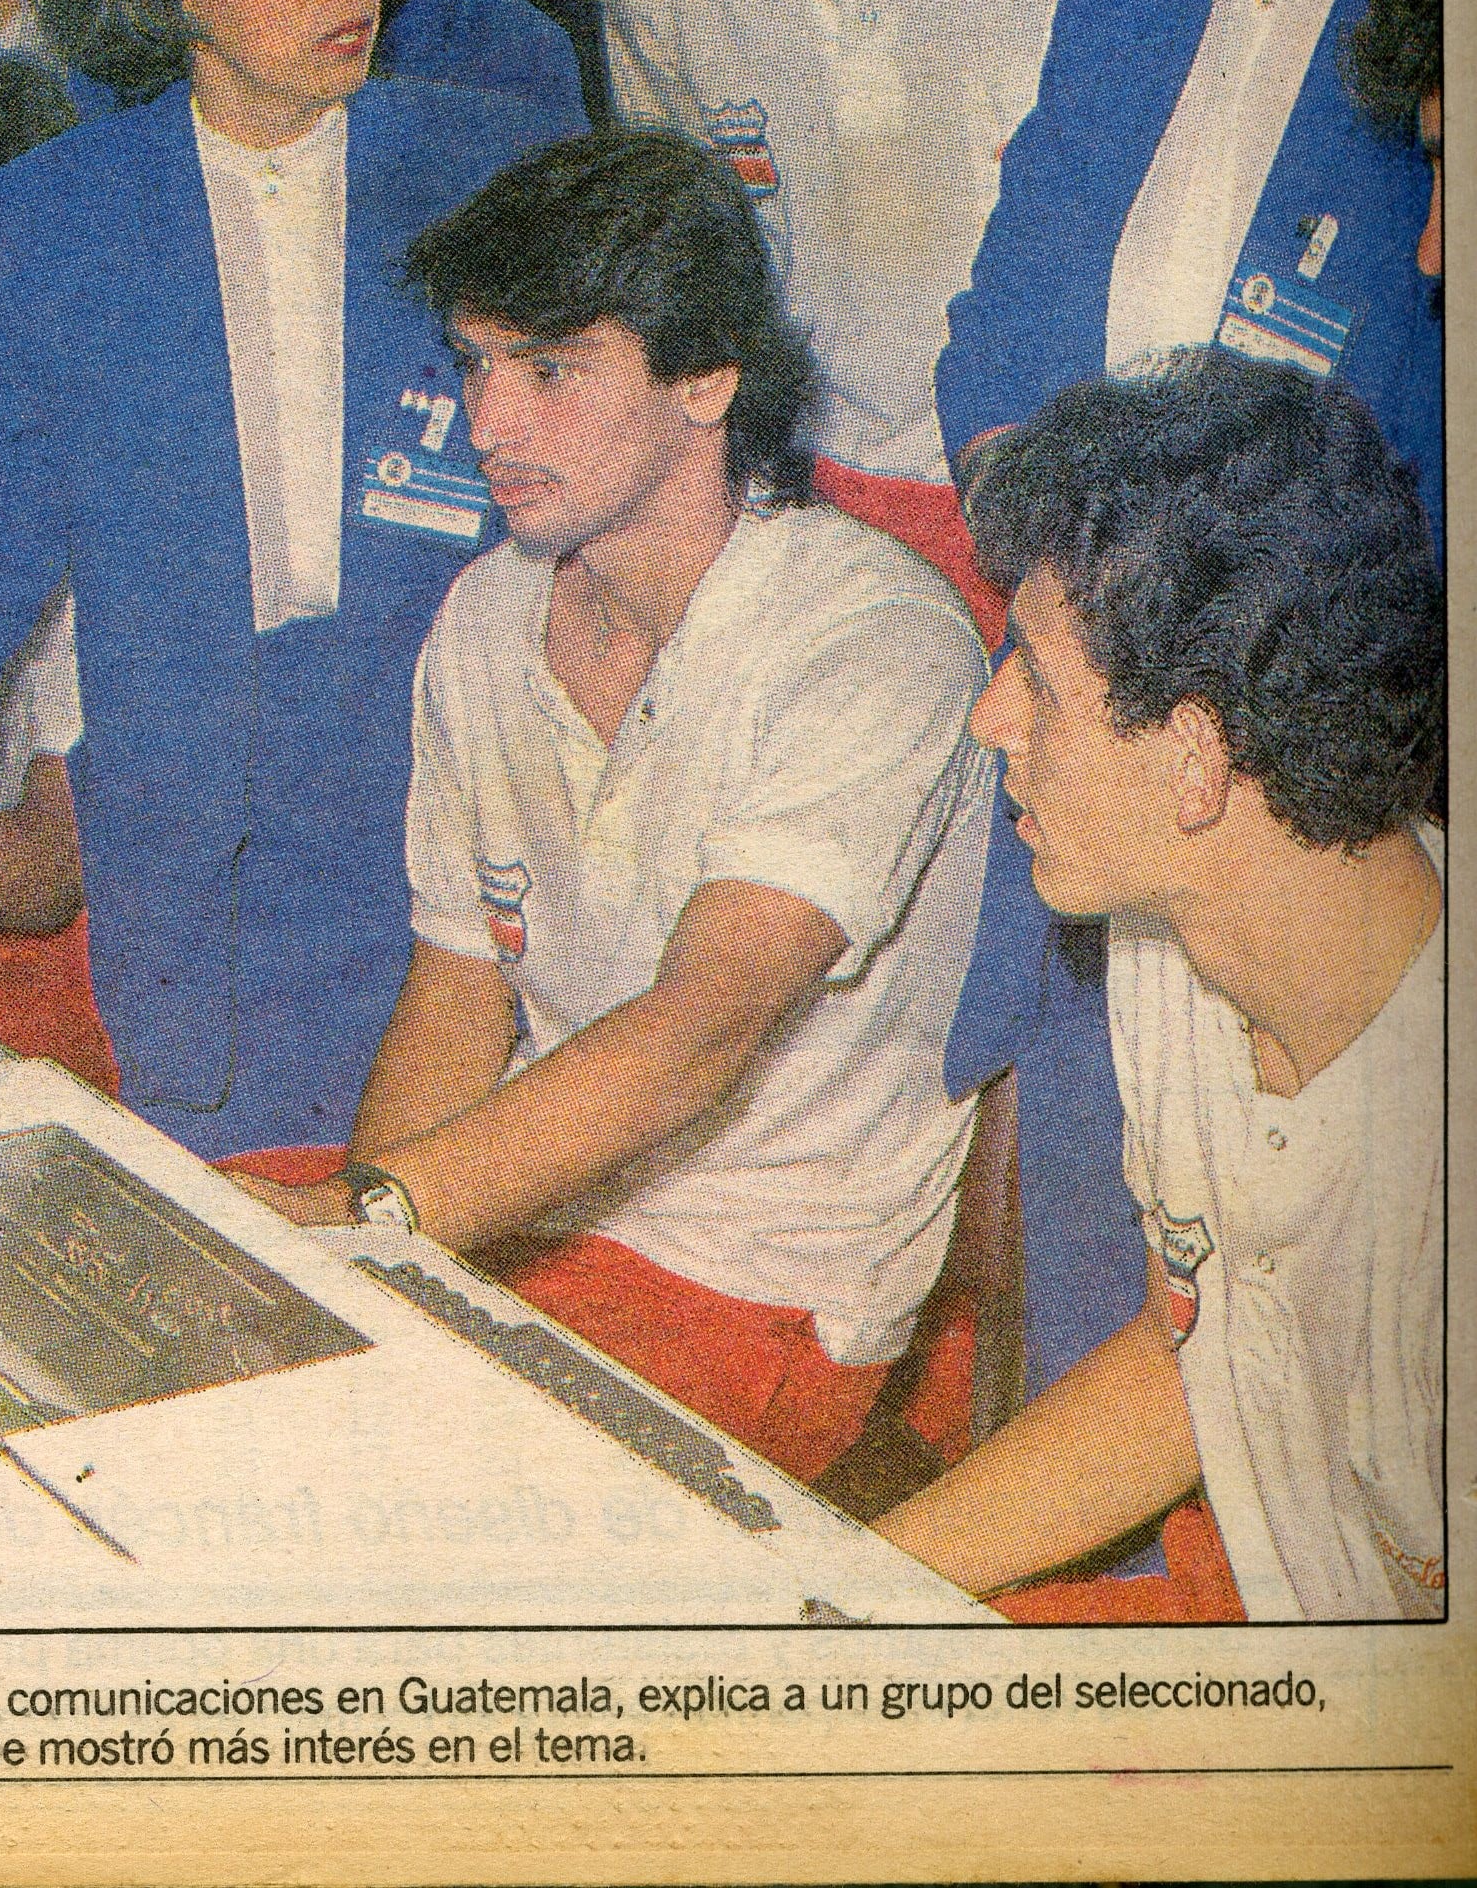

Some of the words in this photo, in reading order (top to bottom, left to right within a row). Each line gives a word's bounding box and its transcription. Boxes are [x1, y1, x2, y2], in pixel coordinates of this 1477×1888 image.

[40, 1728, 174, 1765] mostró
[190, 1728, 269, 1764] más
[285, 1727, 415, 1764] interés
[429, 1736, 474, 1763] en
[490, 1727, 520, 1762] el
[535, 1728, 645, 1762] tema.
